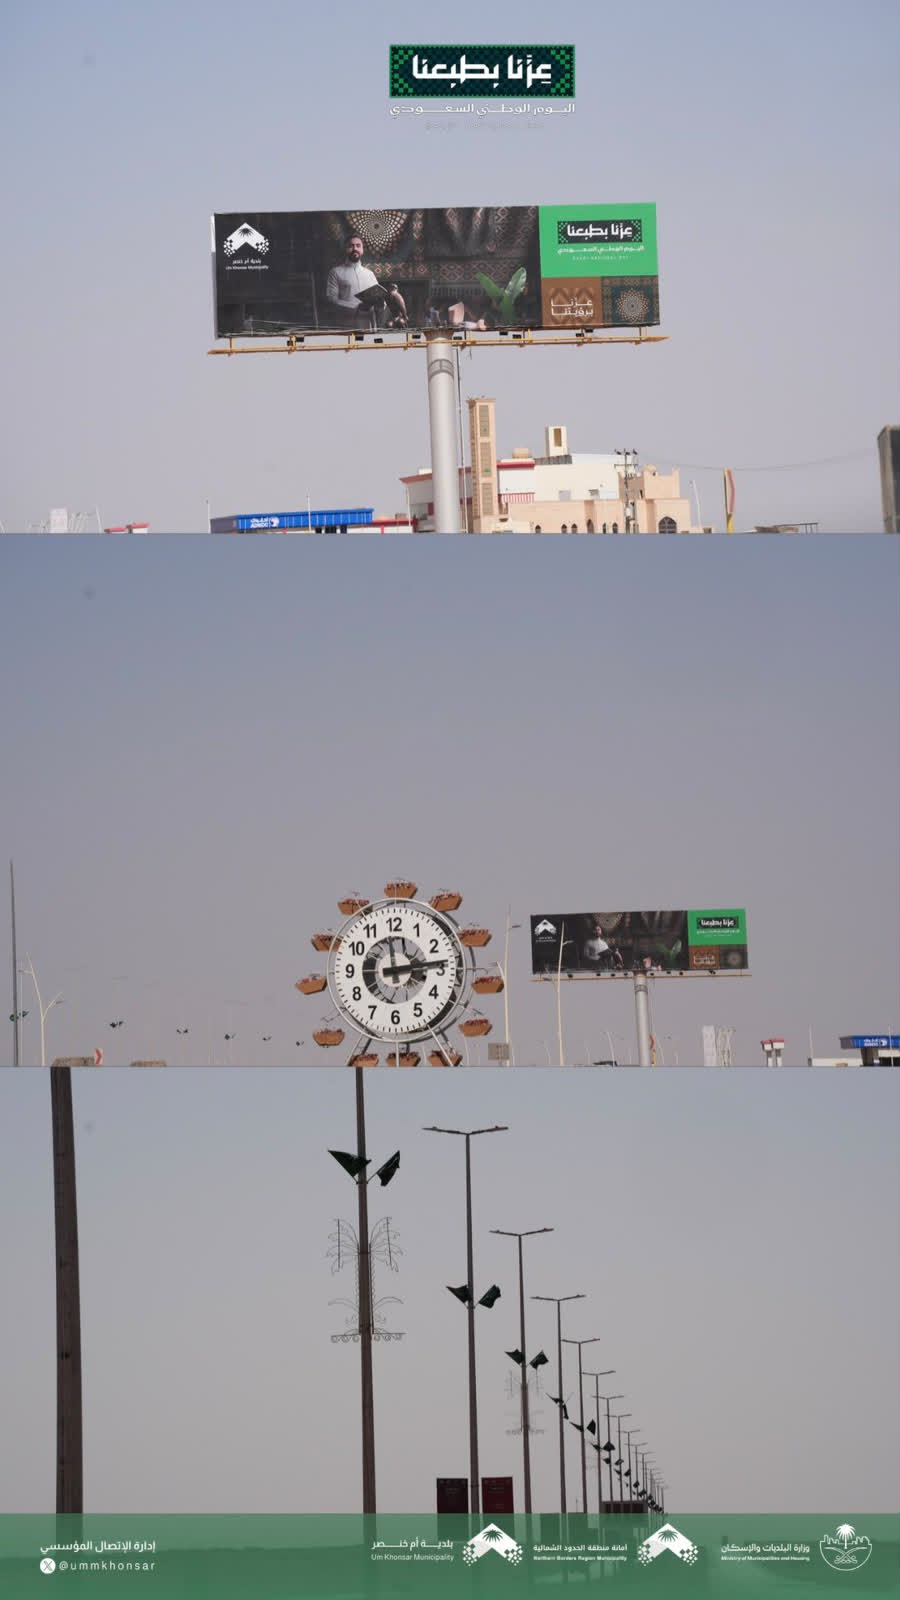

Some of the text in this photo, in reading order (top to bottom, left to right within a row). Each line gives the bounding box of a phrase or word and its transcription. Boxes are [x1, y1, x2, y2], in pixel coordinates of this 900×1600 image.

[567, 224, 608, 240] بطبعنا
[363, 924, 377, 938] 11
[386, 917, 402, 932] 12
[413, 923, 420, 937] 1
[349, 941, 364, 956] 10
[429, 939, 439, 953] 2
[346, 964, 354, 978] 9
[352, 986, 361, 1001] 8
[429, 985, 439, 999] 4
[368, 1005, 377, 1020] 7
[413, 1002, 423, 1017] 5
[391, 1010, 400, 1025] 6
